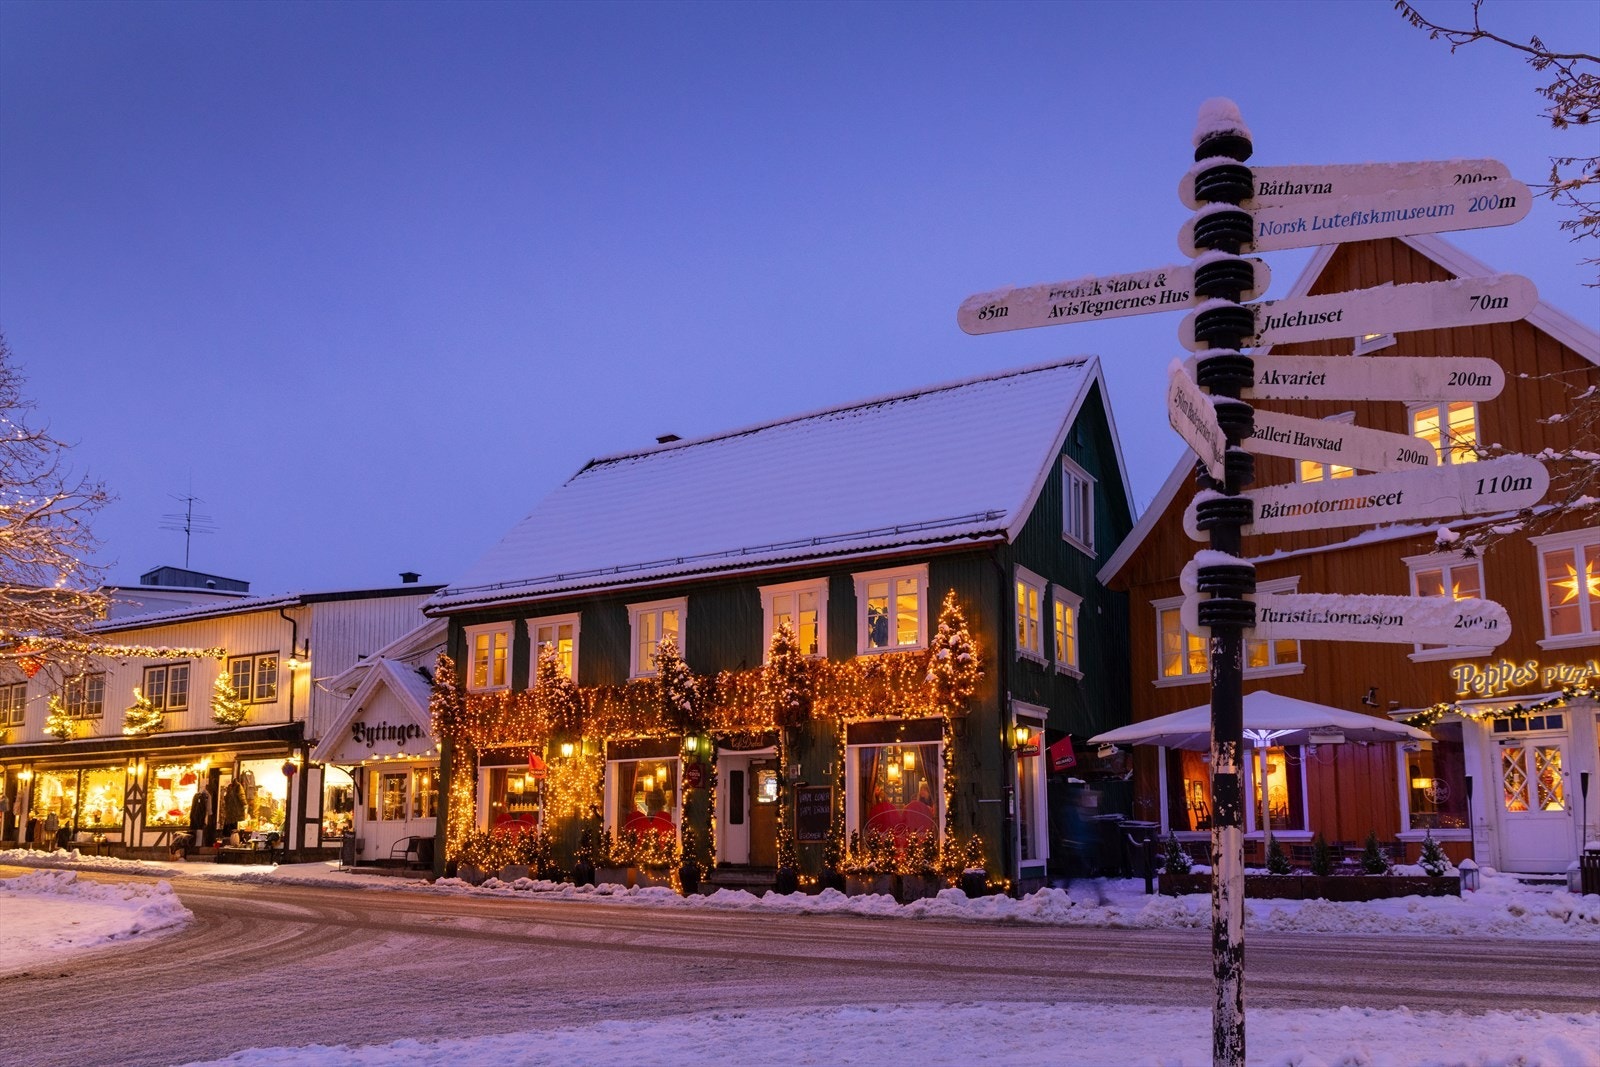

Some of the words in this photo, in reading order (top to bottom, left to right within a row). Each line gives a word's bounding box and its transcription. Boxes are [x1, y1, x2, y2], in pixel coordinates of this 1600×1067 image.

[1258, 180, 1332, 196] Båthavna
[1259, 218, 1307, 236] Norsk
[1312, 203, 1455, 231] Lutefiskmuseum
[1468, 195, 1516, 213] 200m
[1154, 273, 1167, 288] &
[978, 306, 1009, 320] 85m
[1048, 294, 1157, 318] AvisTegnernes
[1158, 290, 1190, 304] Hus
[1262, 308, 1344, 332] Julehuset
[1469, 294, 1509, 312] 70m
[1259, 370, 1326, 386] Akvariet
[1448, 372, 1492, 387] 200m
[1250, 424, 1291, 444] Galleri
[1294, 432, 1343, 452] Havstad
[1396, 448, 1429, 465] 200m
[1260, 490, 1404, 519] Båtmotormuseet
[1475, 476, 1533, 496] 110m
[1450, 659, 1538, 697] Peppes
